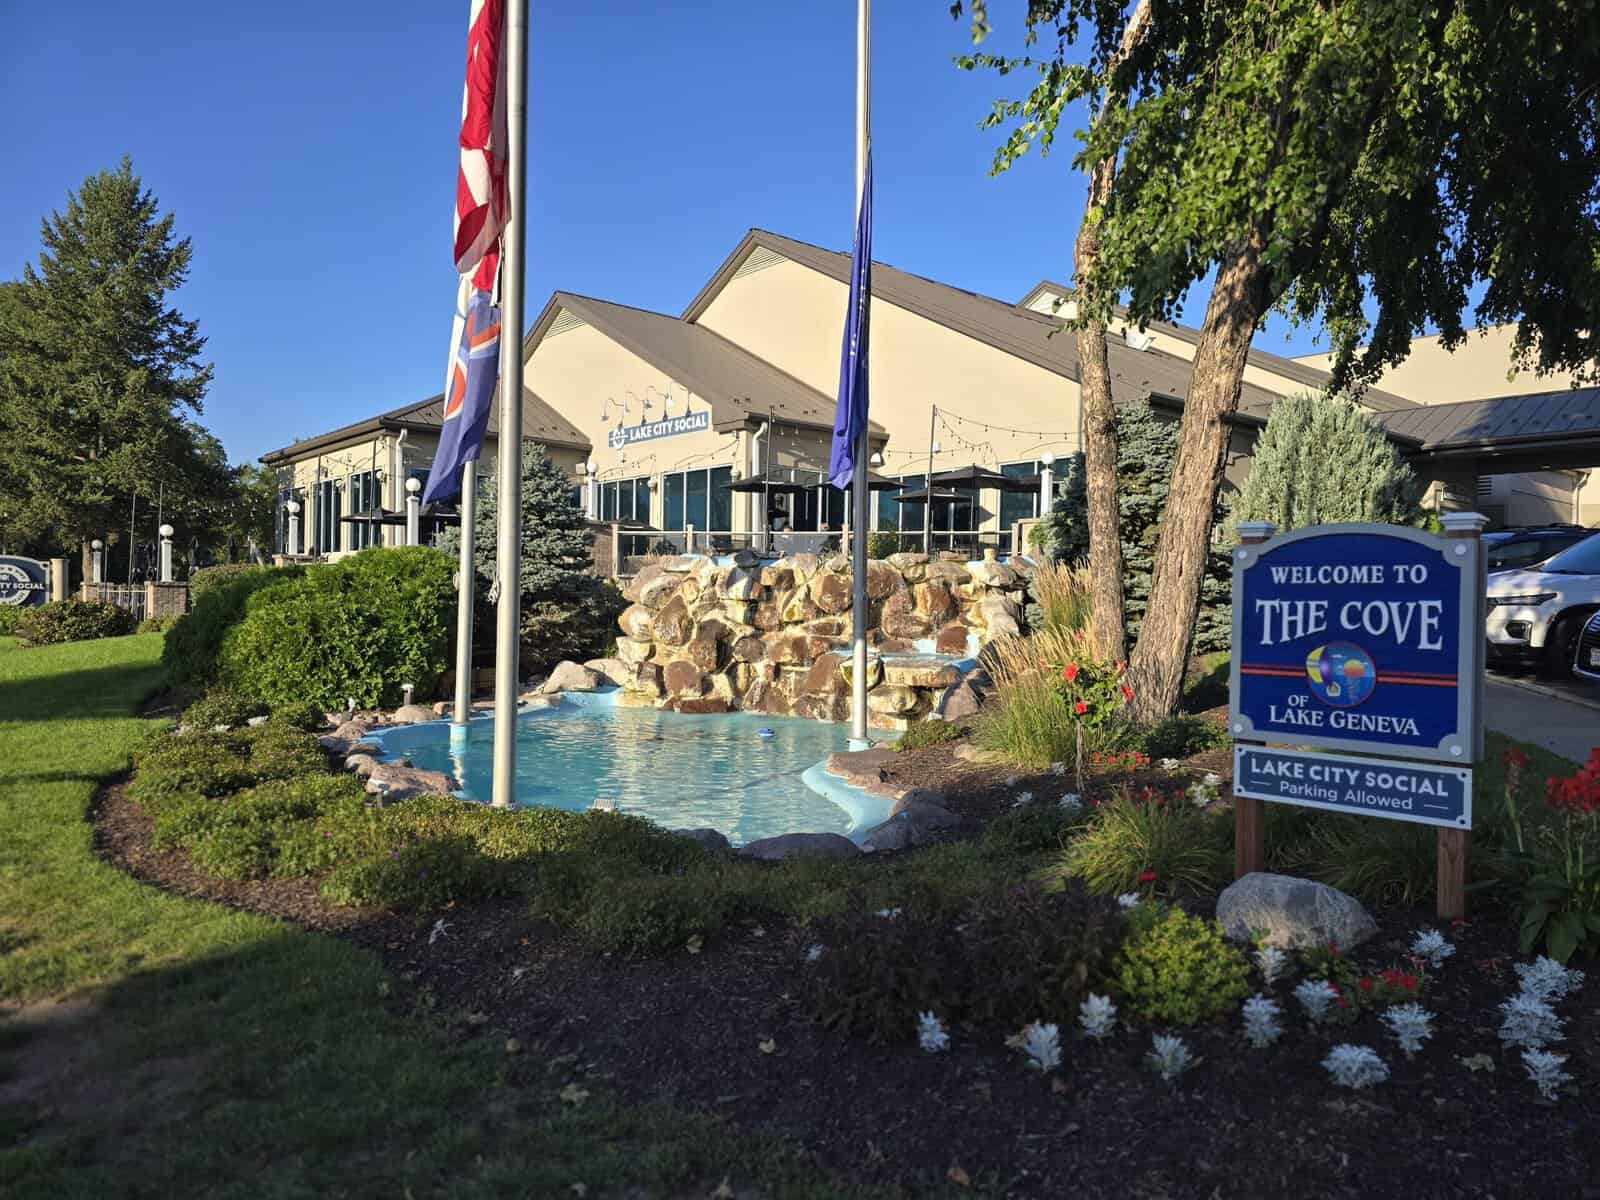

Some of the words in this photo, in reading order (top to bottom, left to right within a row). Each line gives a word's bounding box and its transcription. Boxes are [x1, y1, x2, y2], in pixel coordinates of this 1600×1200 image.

[630, 426, 652, 440] LAKE
[653, 421, 673, 435] CITY
[674, 415, 706, 431] SOCIAL
[13, 582, 44, 590] SOCIAL
[1271, 565, 1385, 584] WELCOME
[1393, 564, 1428, 584] TO
[1256, 599, 1328, 645] THE
[1340, 600, 1443, 650] COVE
[1287, 694, 1309, 707] OF
[1269, 705, 1324, 727] LAKE
[1330, 710, 1420, 736] GENEVA
[1251, 758, 1304, 778] LAKE
[1309, 767, 1361, 785] CITY
[1365, 771, 1449, 797] SOCIAL
[1280, 780, 1338, 802] Parking
[1344, 789, 1413, 810] Allowed
